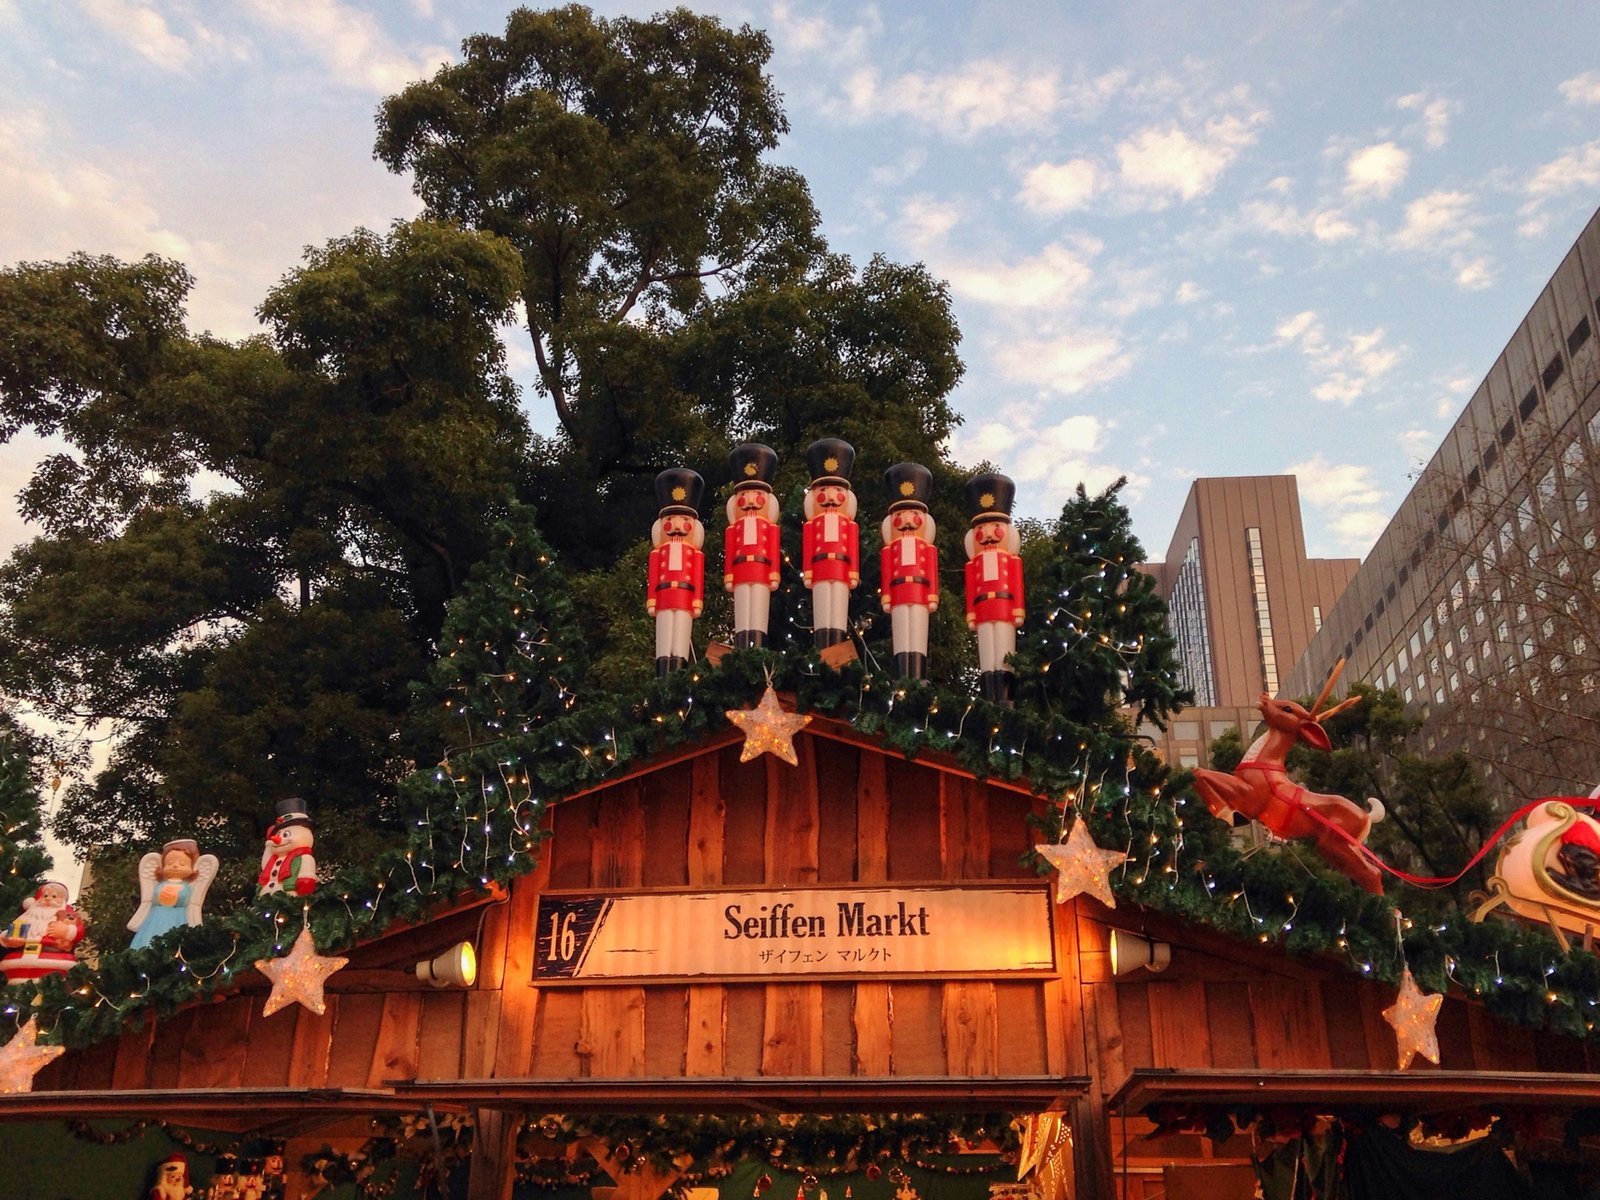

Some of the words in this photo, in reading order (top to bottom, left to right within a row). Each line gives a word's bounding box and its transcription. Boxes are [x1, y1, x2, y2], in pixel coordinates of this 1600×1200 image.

[547, 912, 577, 961] 16
[724, 903, 827, 940] Seiffen
[837, 901, 931, 937] Markt
[759, 949, 829, 964] ザイフェン
[837, 947, 893, 963] マルクト
